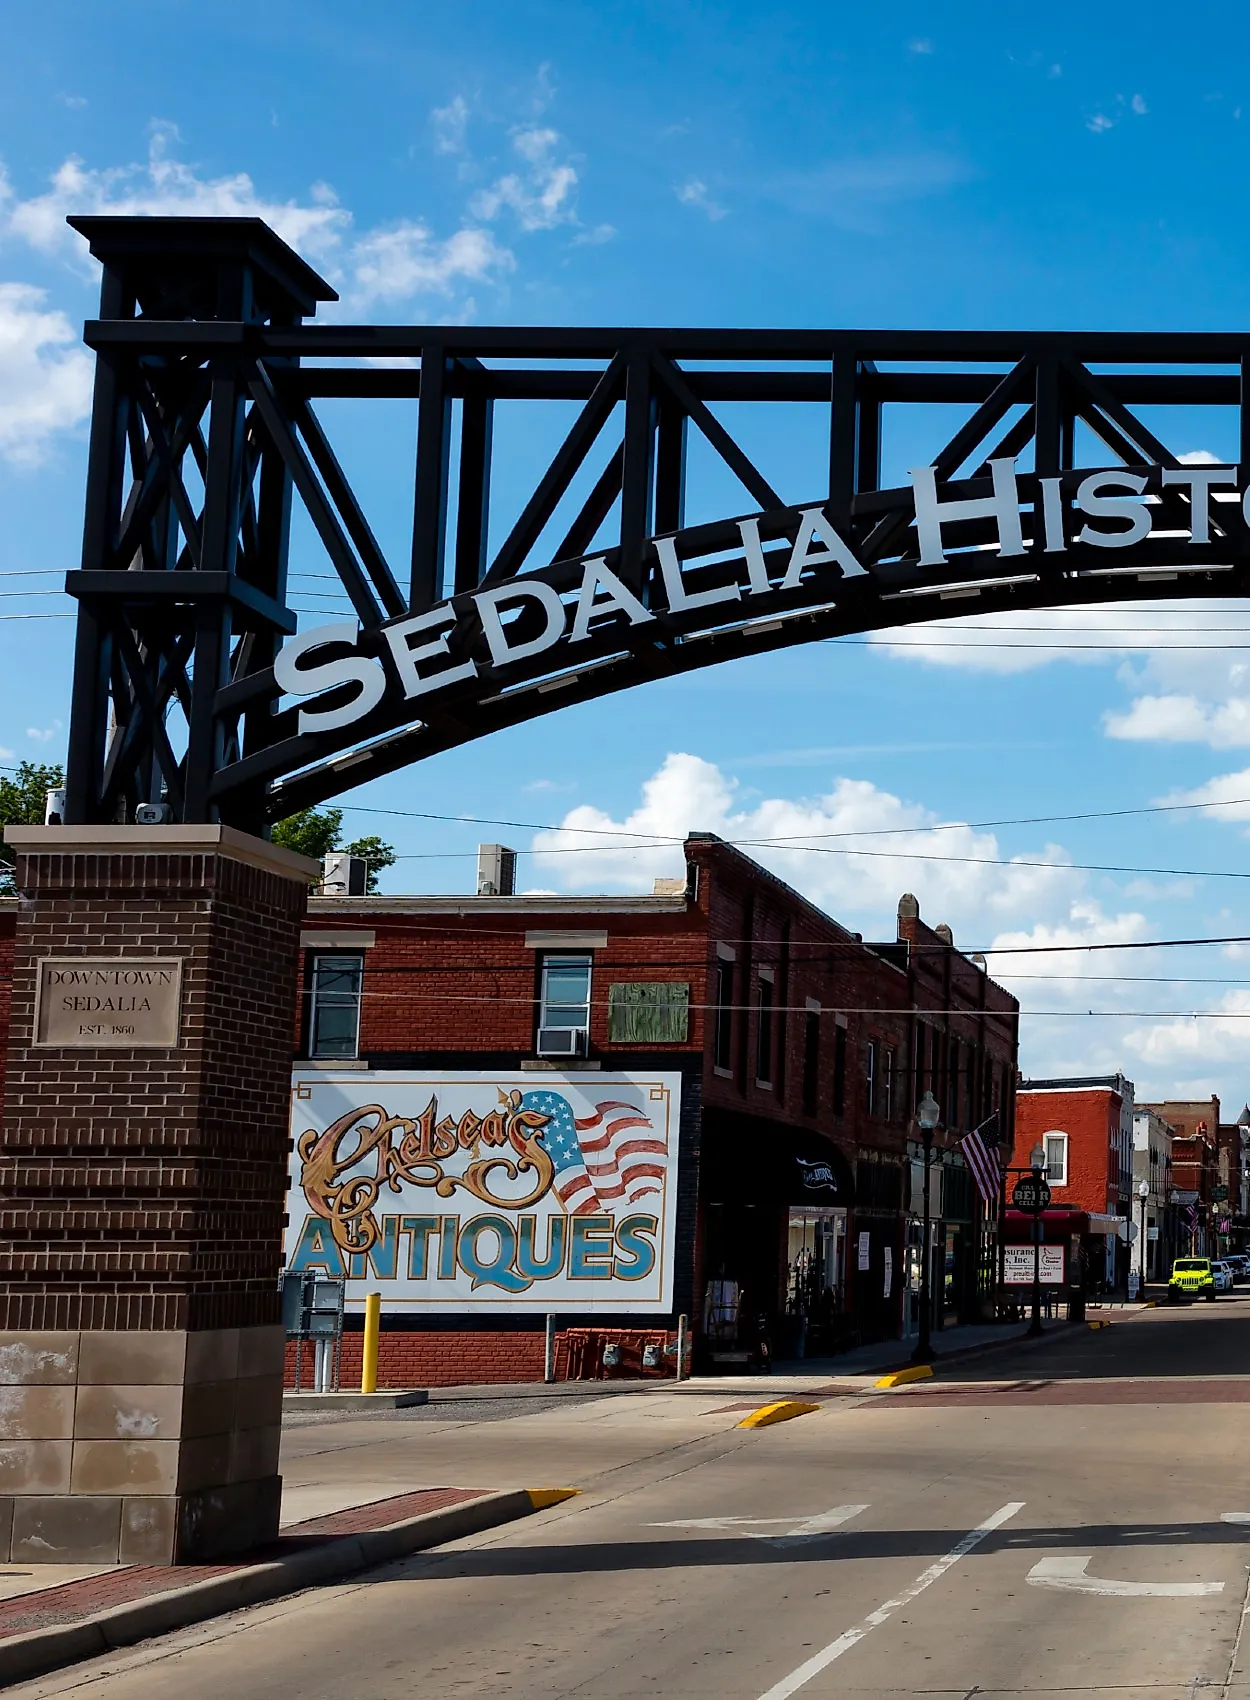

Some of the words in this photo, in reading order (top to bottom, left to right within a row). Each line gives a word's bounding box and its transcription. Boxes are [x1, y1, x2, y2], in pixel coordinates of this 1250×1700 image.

[273, 506, 870, 736] SEDALIA
[48, 970, 173, 986] DOWNTOWN
[62, 996, 151, 1011] SEDALIA
[79, 1024, 106, 1035] EST.
[111, 1024, 135, 1035] 1860
[299, 1089, 556, 1255] Chelsea's
[290, 1212, 660, 1293] ANTIQUES
[1013, 1256, 1030, 1264] Inc.
